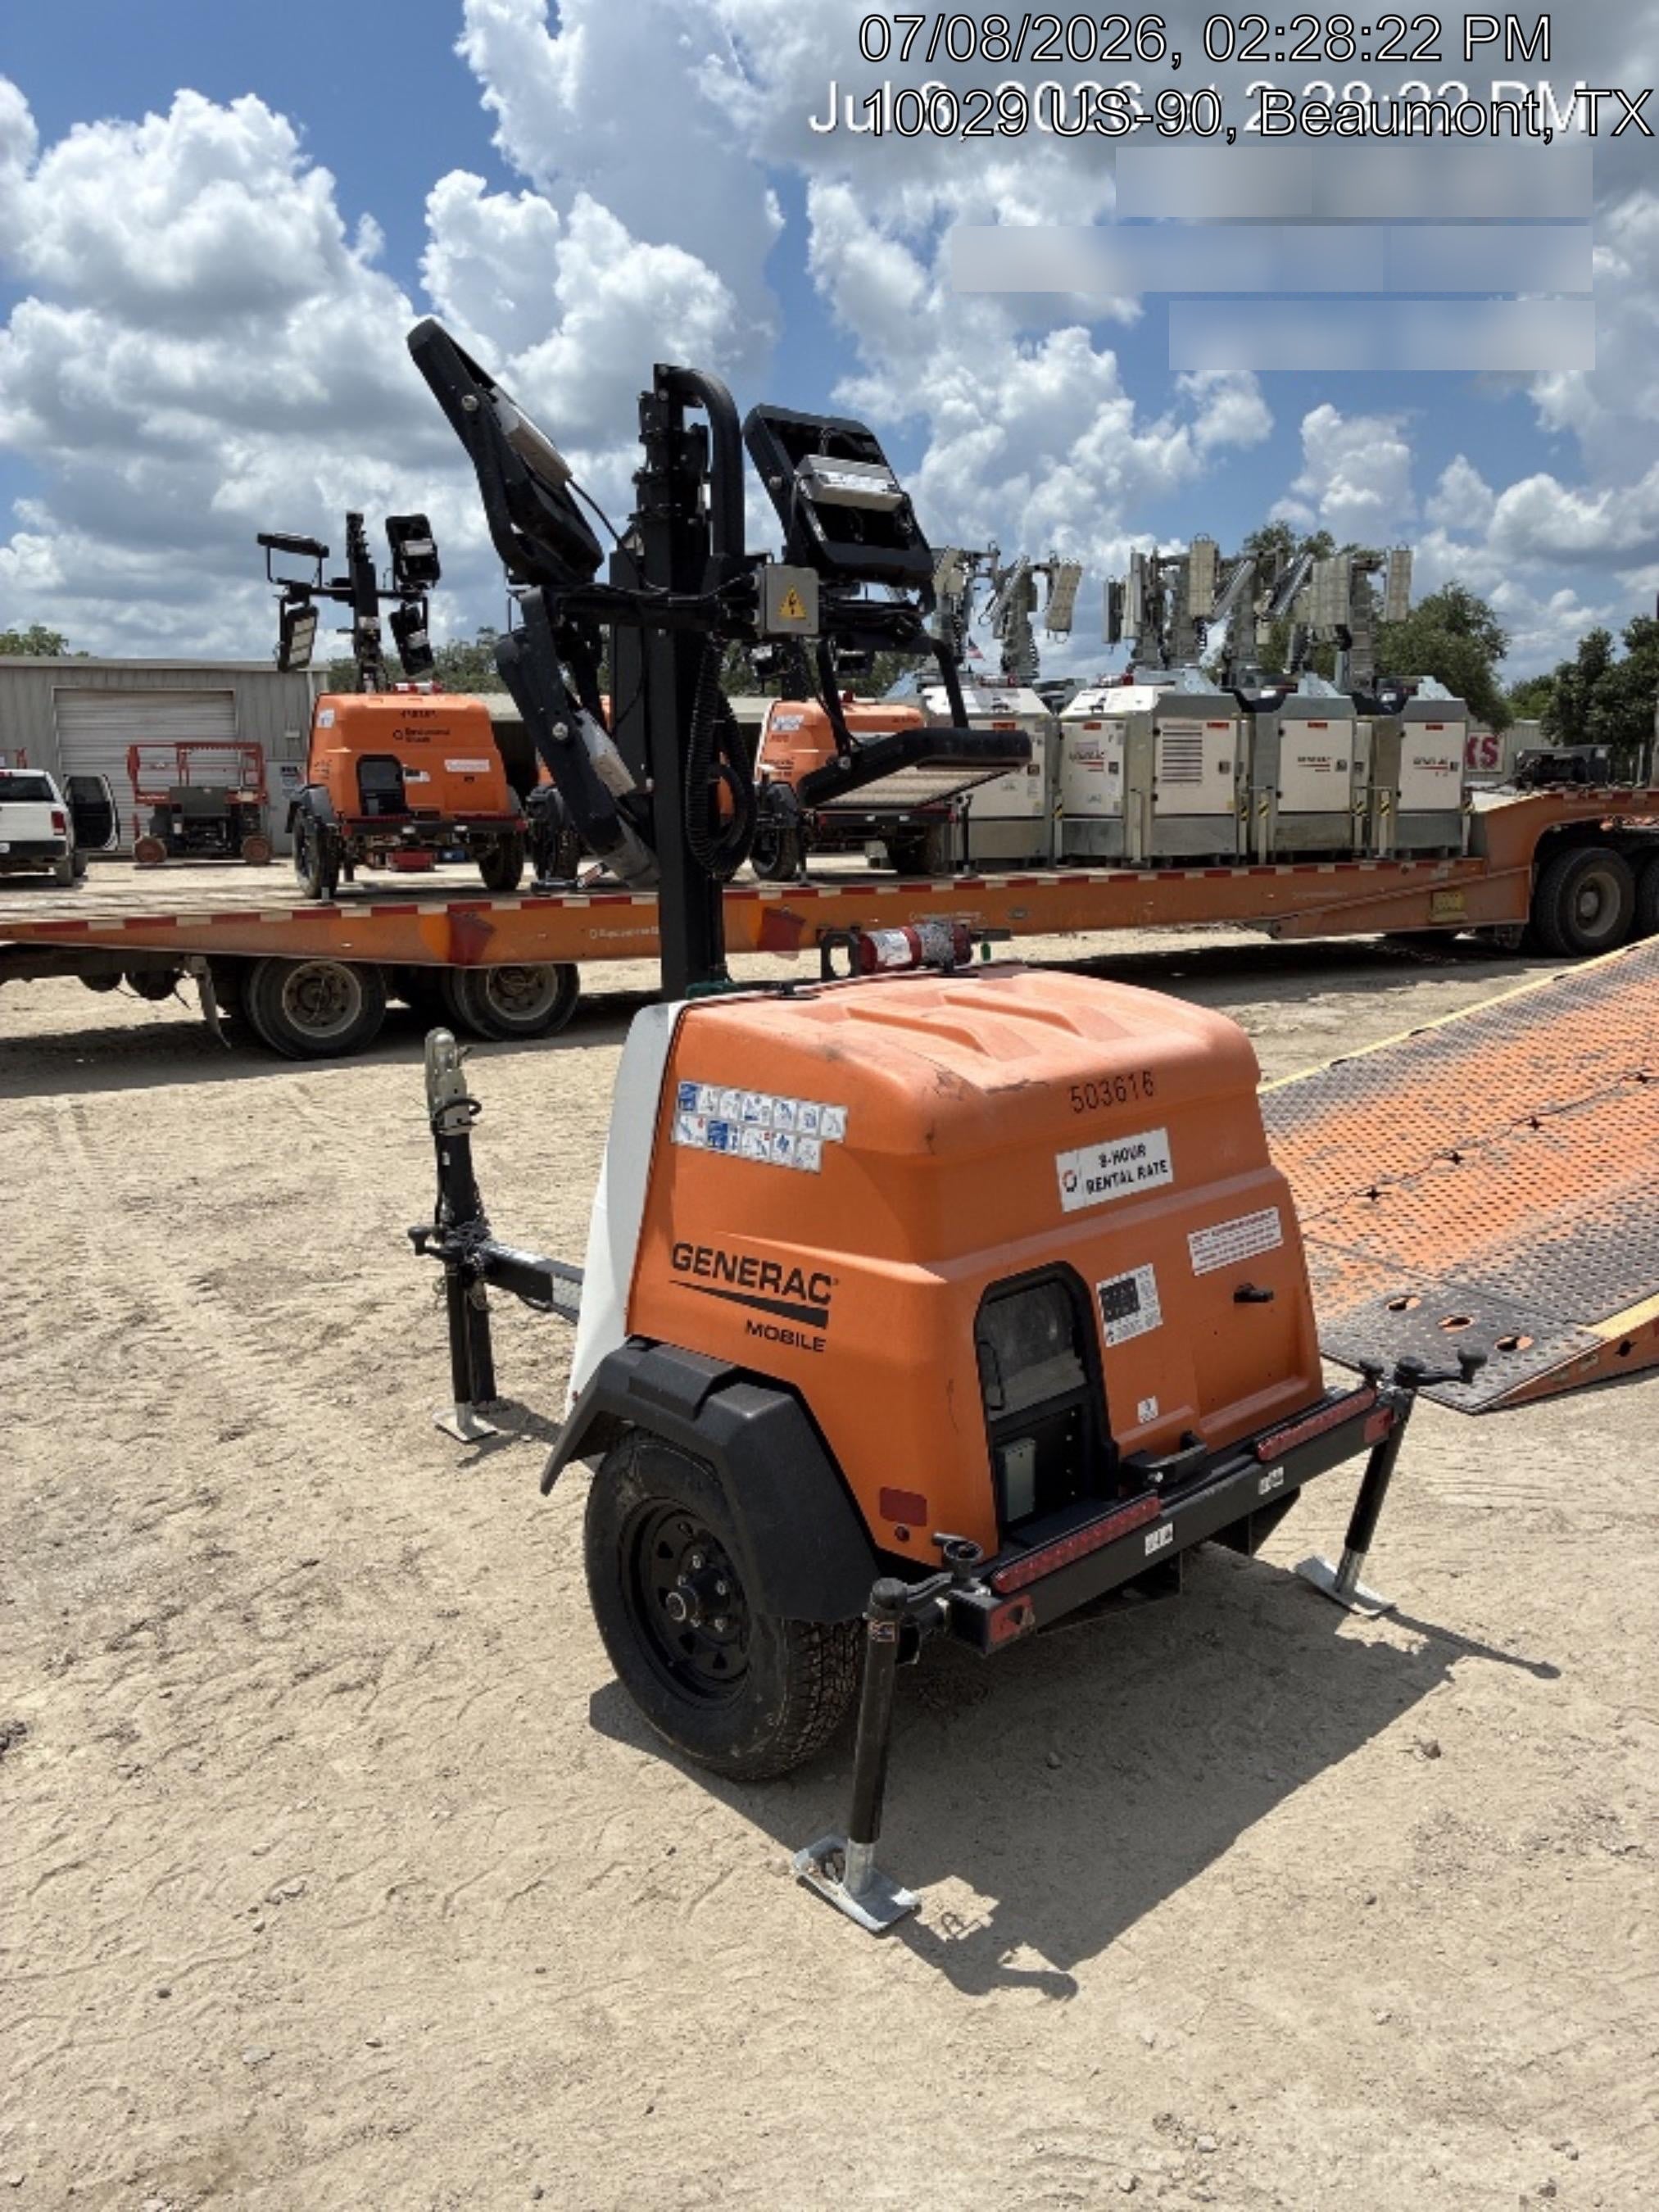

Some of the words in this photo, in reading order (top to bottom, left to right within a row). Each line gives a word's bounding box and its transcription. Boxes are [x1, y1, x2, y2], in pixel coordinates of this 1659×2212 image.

[1070, 1071, 1155, 1114] 503616
[1086, 1172, 1135, 1195] RENTAL
[1137, 1159, 1168, 1182] RATE
[672, 1242, 832, 1306] GENERAC
[745, 1319, 827, 1353] MOBILE
